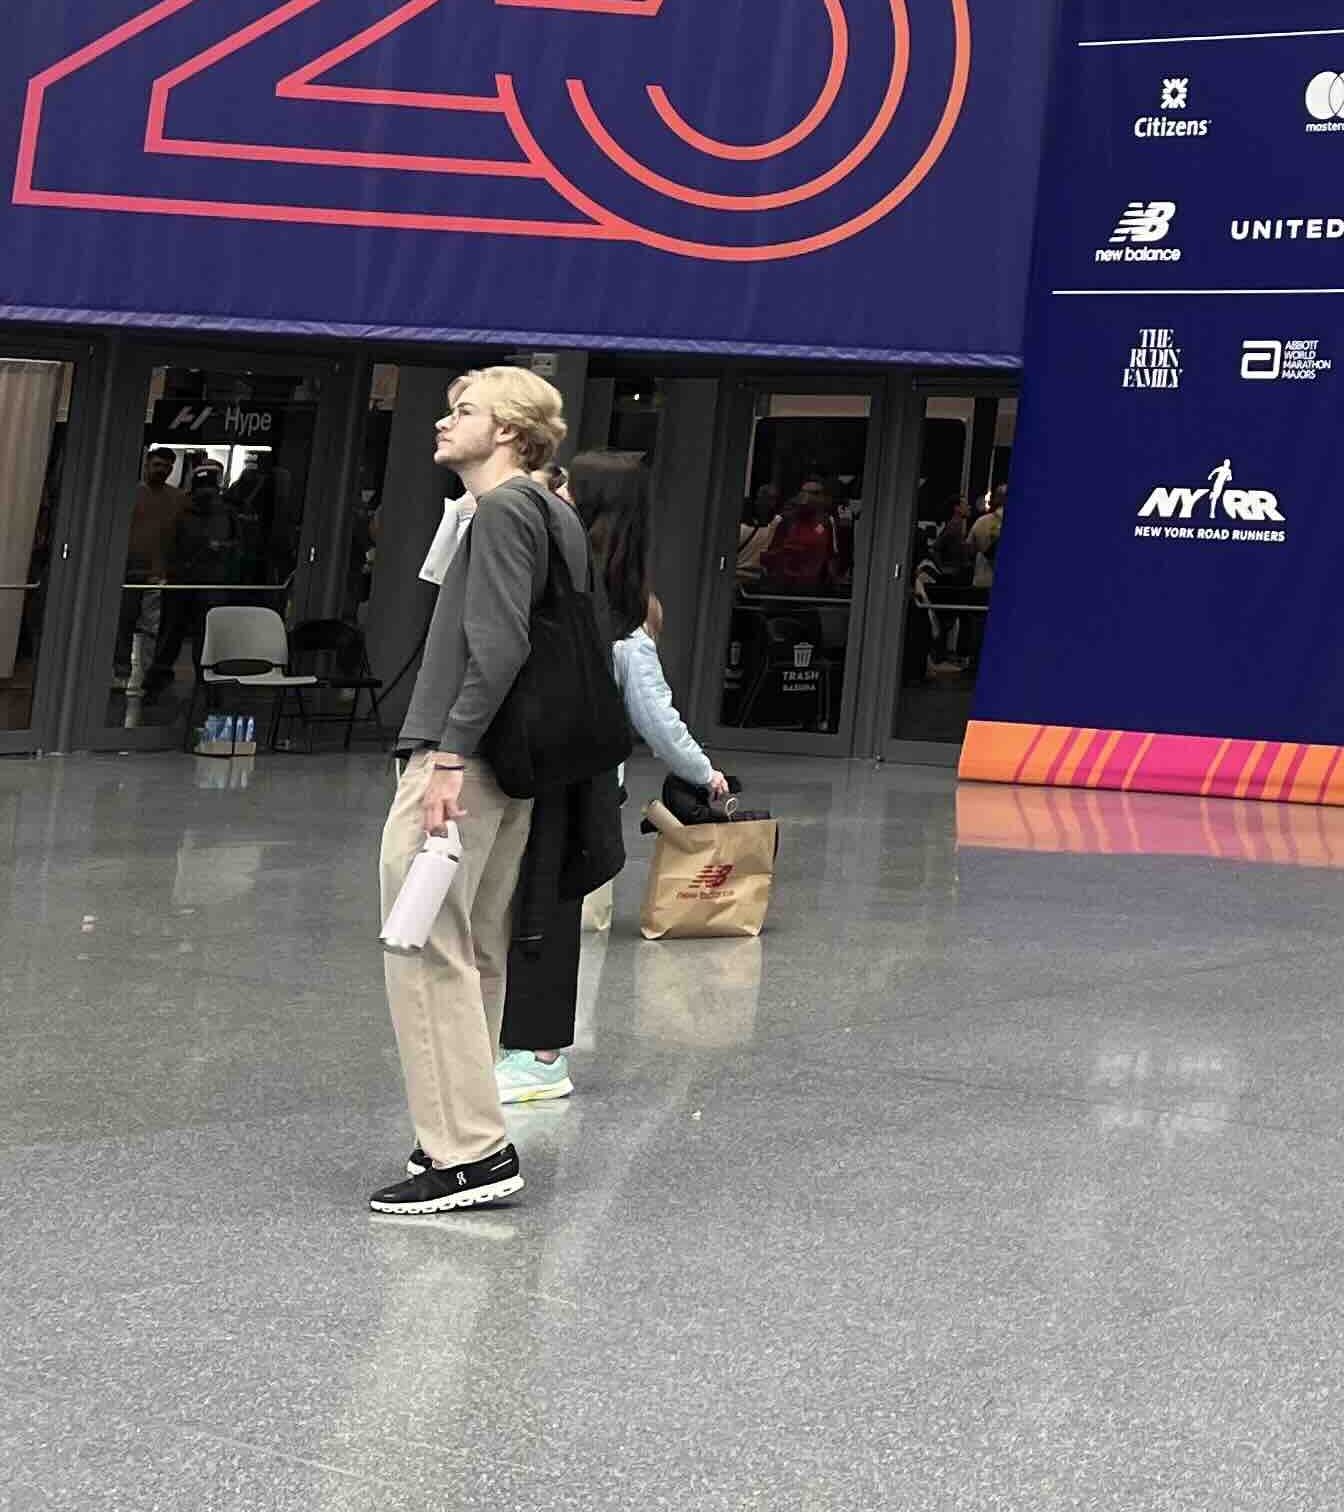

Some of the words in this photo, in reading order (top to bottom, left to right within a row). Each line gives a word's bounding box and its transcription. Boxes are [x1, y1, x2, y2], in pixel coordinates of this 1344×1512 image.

[1134, 117, 1210, 137] Citizens
[1231, 218, 1344, 240] UNITED
[1095, 249, 1122, 262] new
[1124, 247, 1181, 262] balance
[1139, 329, 1174, 349] THE
[1129, 349, 1182, 368] RUDIN
[1283, 350, 1317, 360] WORLD
[1282, 359, 1332, 370] MARATHON
[1121, 368, 1184, 388] FAMILY
[1281, 369, 1317, 380] MAJORS
[224, 406, 272, 437] Hype
[1134, 525, 1162, 538] NEW
[1164, 527, 1195, 539] YORK
[1197, 528, 1230, 540] ROAD
[1232, 530, 1286, 543] RUNNERS
[782, 671, 820, 681] TRASH
